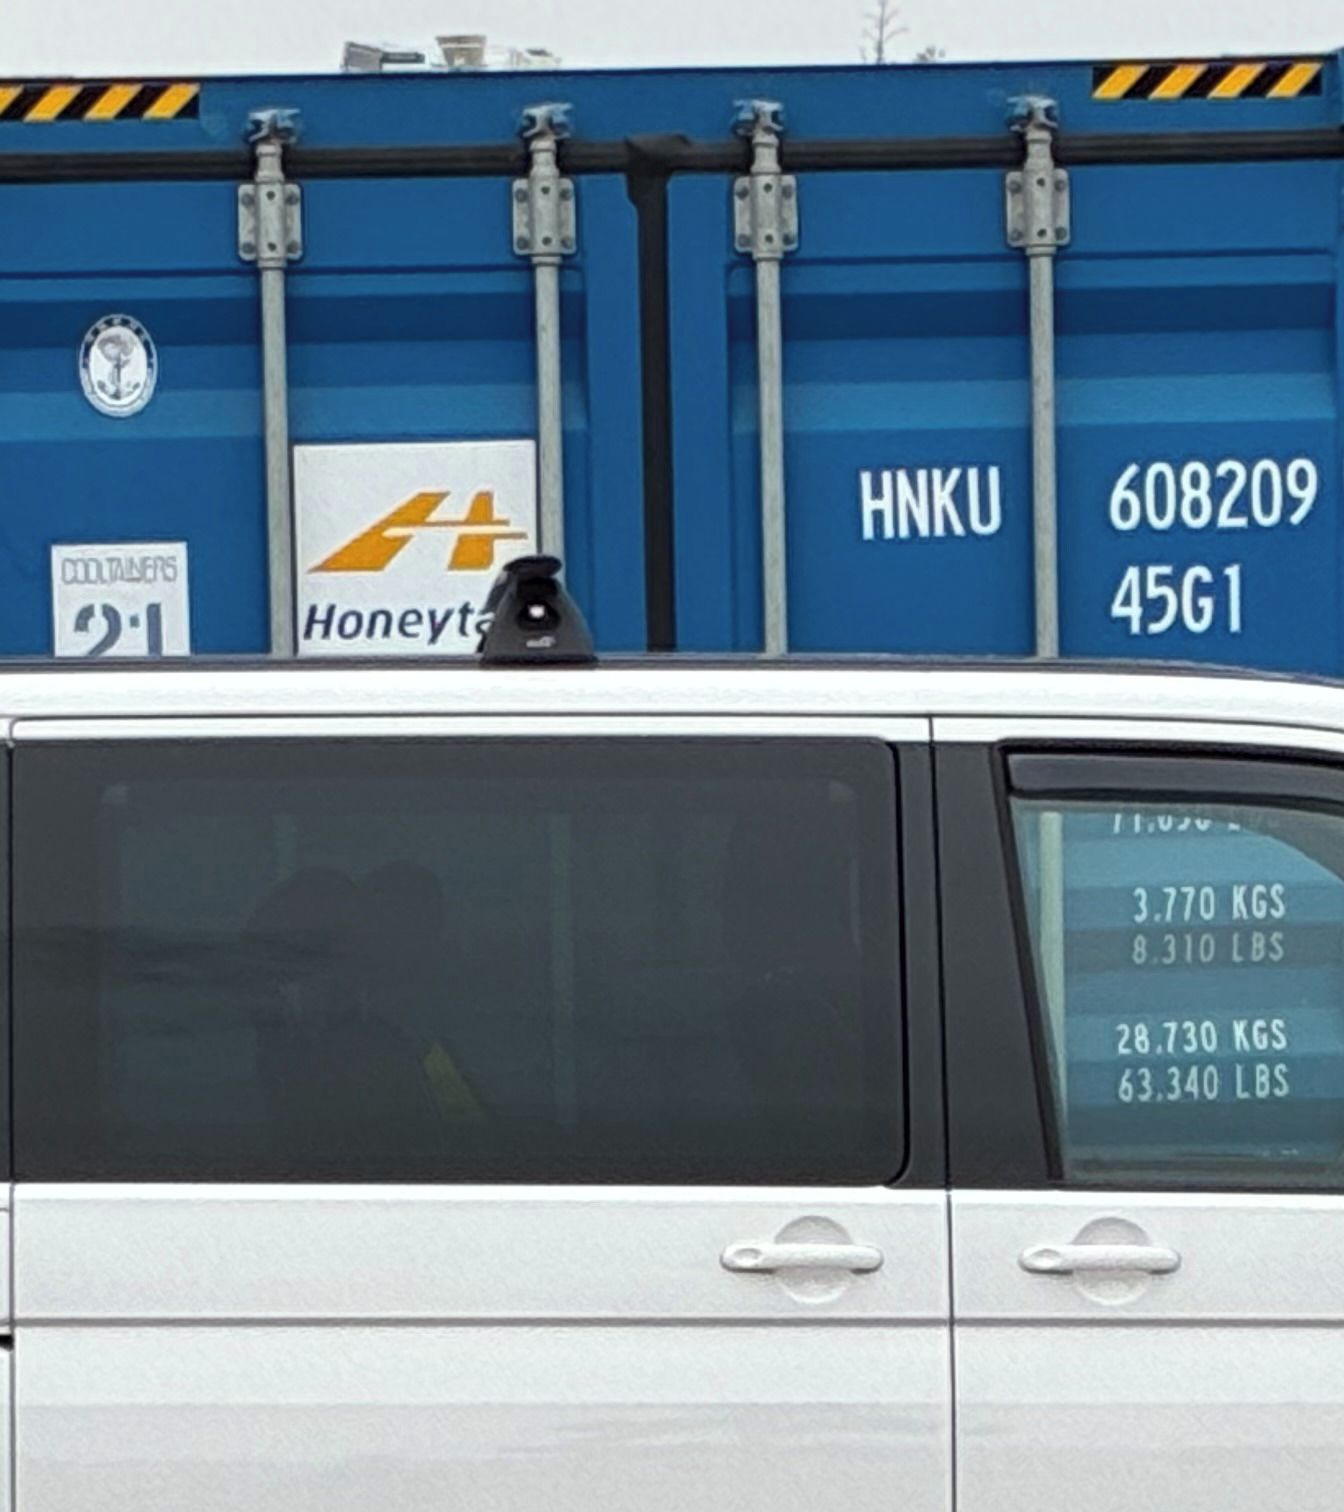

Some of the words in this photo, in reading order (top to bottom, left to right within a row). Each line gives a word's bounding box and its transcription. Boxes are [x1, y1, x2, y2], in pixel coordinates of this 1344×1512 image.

[860, 466, 1002, 540] HNKU
[1109, 458, 1317, 531] 608209
[1111, 563, 1241, 635] 45G1
[74, 602, 163, 657] 21
[303, 600, 494, 646] Honeyta
[1132, 885, 1216, 923] 3.770
[1232, 883, 1286, 920] KGS
[1132, 933, 1216, 965] 8.310
[1232, 931, 1285, 963] LBS
[1116, 1021, 1218, 1056] 28.730
[1232, 1018, 1287, 1051] KGS
[1117, 1064, 1219, 1103] 63.340
[1235, 1063, 1289, 1099] LBS
